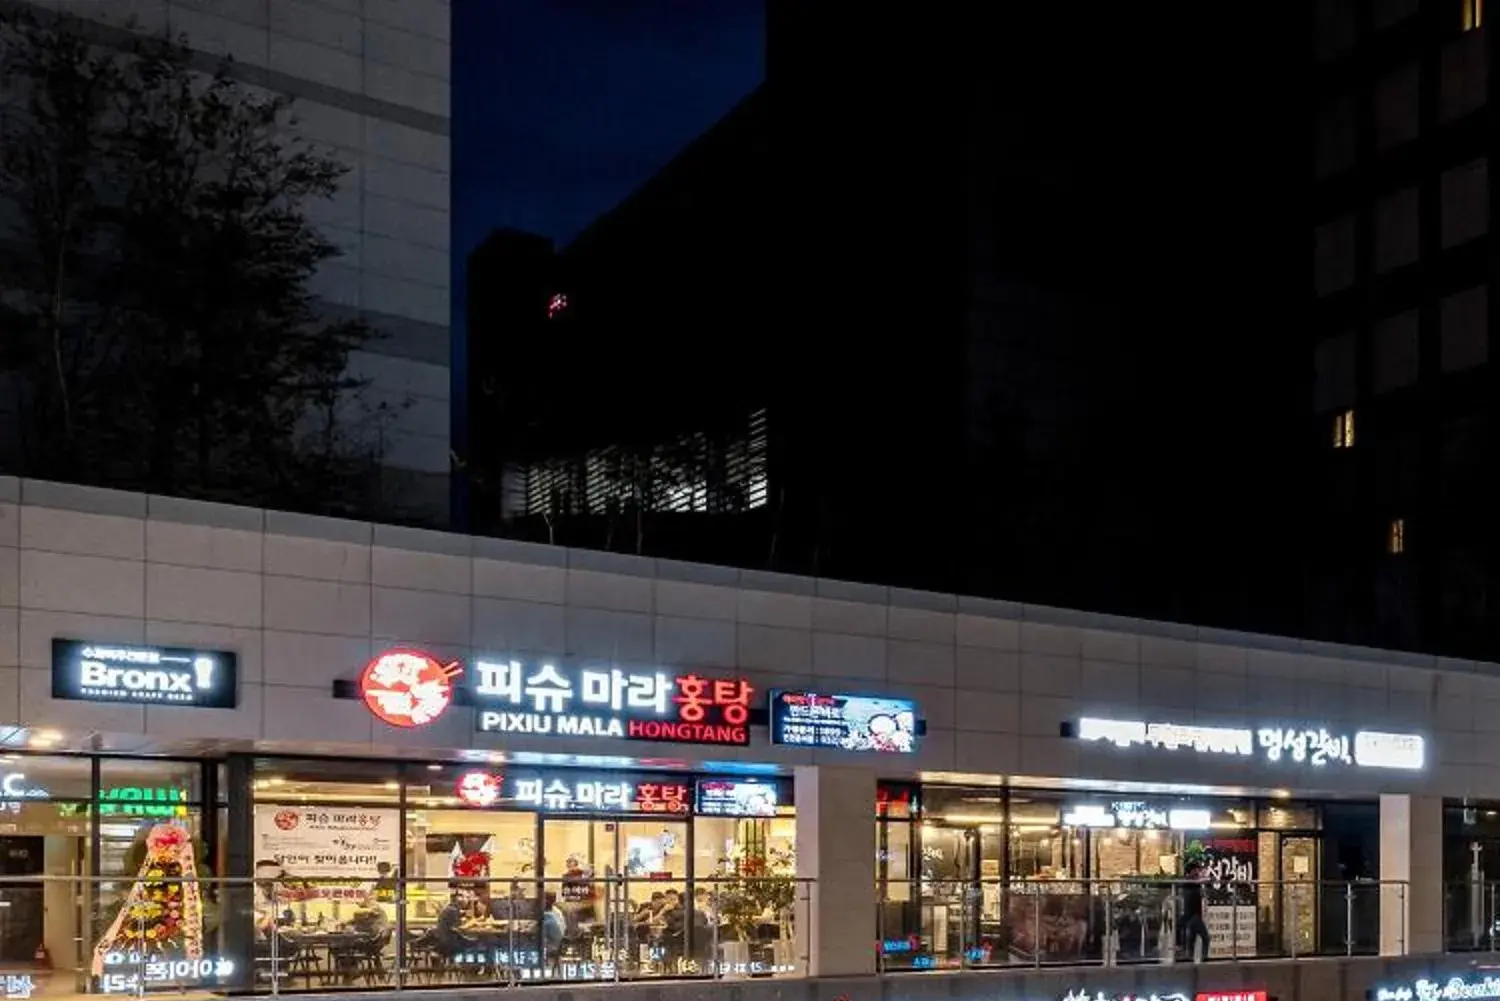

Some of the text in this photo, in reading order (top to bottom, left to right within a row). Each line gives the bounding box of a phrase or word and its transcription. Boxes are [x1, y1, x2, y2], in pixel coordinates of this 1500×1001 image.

[80, 660, 192, 692] Bronx
[477, 660, 754, 724] 피슈 마라 홍탕
[482, 711, 746, 742] PIXIU MALA HONGTANG
[1257, 726, 1352, 765] 명성갈비
[515, 778, 687, 812] 피슈 마라 홍탕
[1202, 855, 1255, 893] 성갈비
